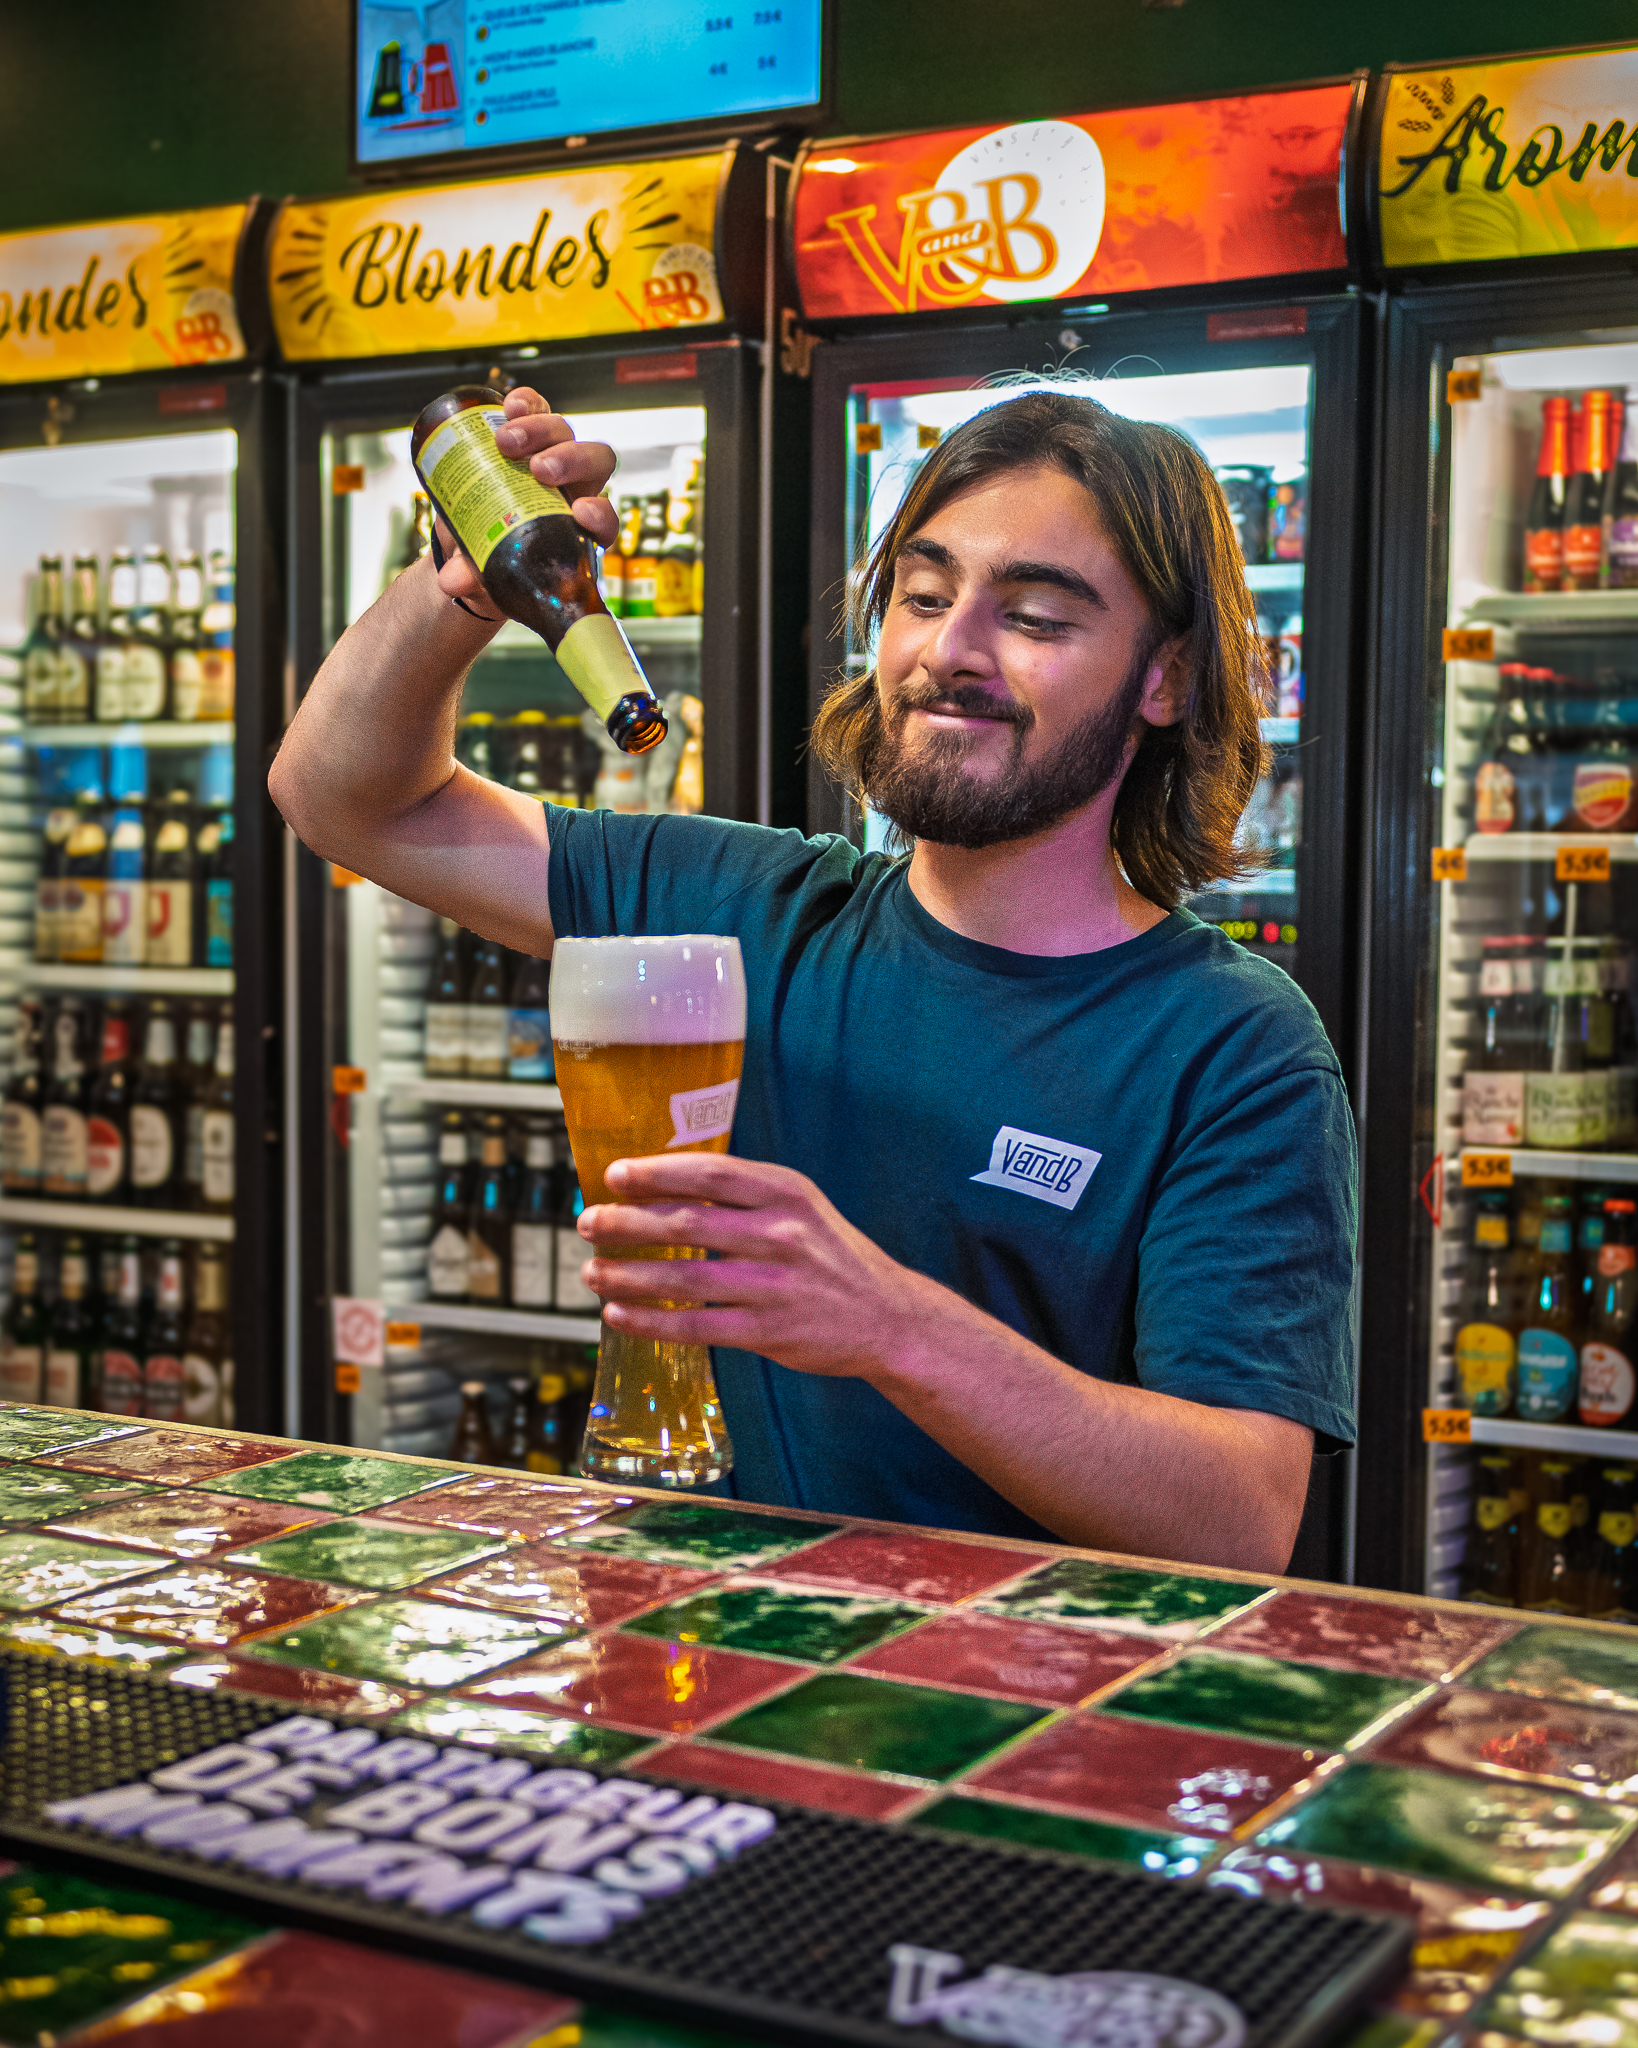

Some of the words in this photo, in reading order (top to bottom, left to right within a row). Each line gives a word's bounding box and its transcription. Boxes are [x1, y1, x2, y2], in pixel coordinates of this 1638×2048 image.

[338, 209, 610, 309] Blondes
[1001, 1138, 1083, 1194] VandB
[150, 1742, 359, 1815] DE
[321, 1778, 718, 1899] BONS
[243, 1714, 777, 1858] PARTAGEUR
